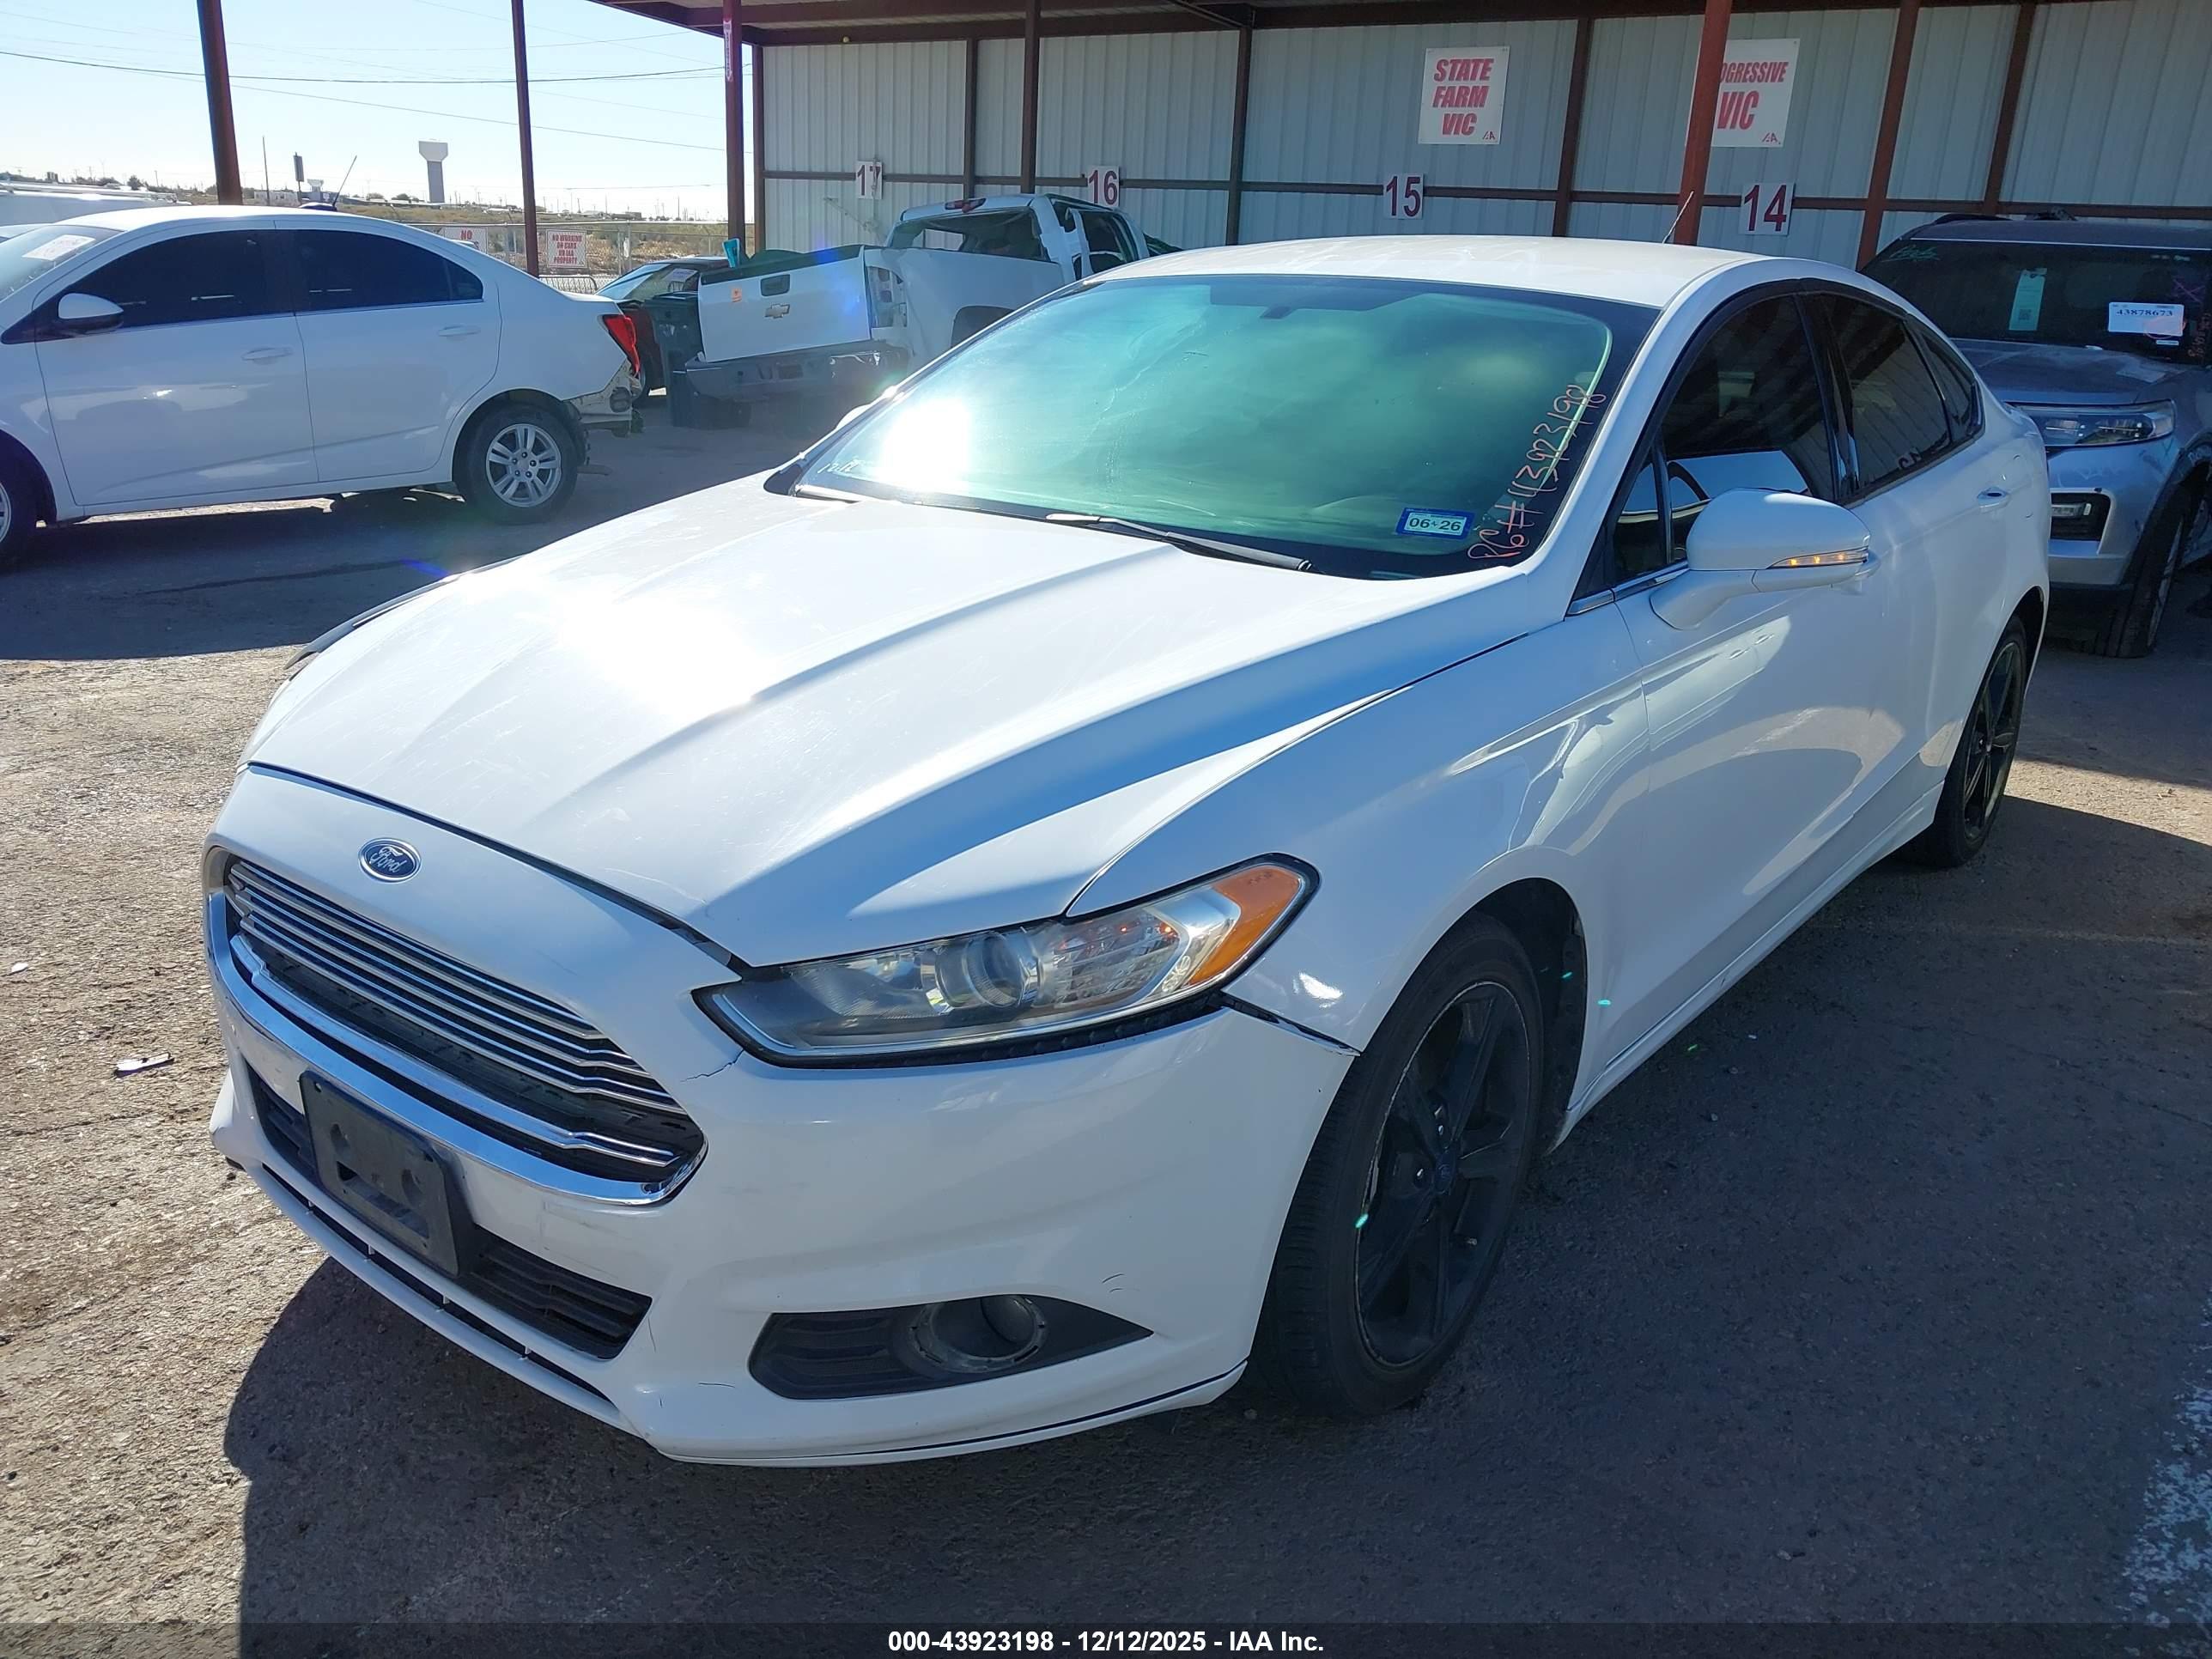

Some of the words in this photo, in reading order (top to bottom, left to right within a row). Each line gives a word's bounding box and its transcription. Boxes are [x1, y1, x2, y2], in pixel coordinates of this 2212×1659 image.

[1433, 58, 1494, 82] STATE
[1719, 61, 1790, 83] OGRESSIVE
[1431, 85, 1490, 108] FARM
[1717, 90, 1759, 131] VIC
[1442, 112, 1478, 136] VIC
[856, 164, 882, 197] 17
[1088, 169, 1117, 205] 16
[1384, 175, 1422, 217] 15
[1743, 184, 1788, 232] 14
[460, 229, 473, 240] NO
[2116, 308, 2173, 317] 43878673
[1409, 517, 1431, 529] 06
[1438, 520, 1462, 532] 26
